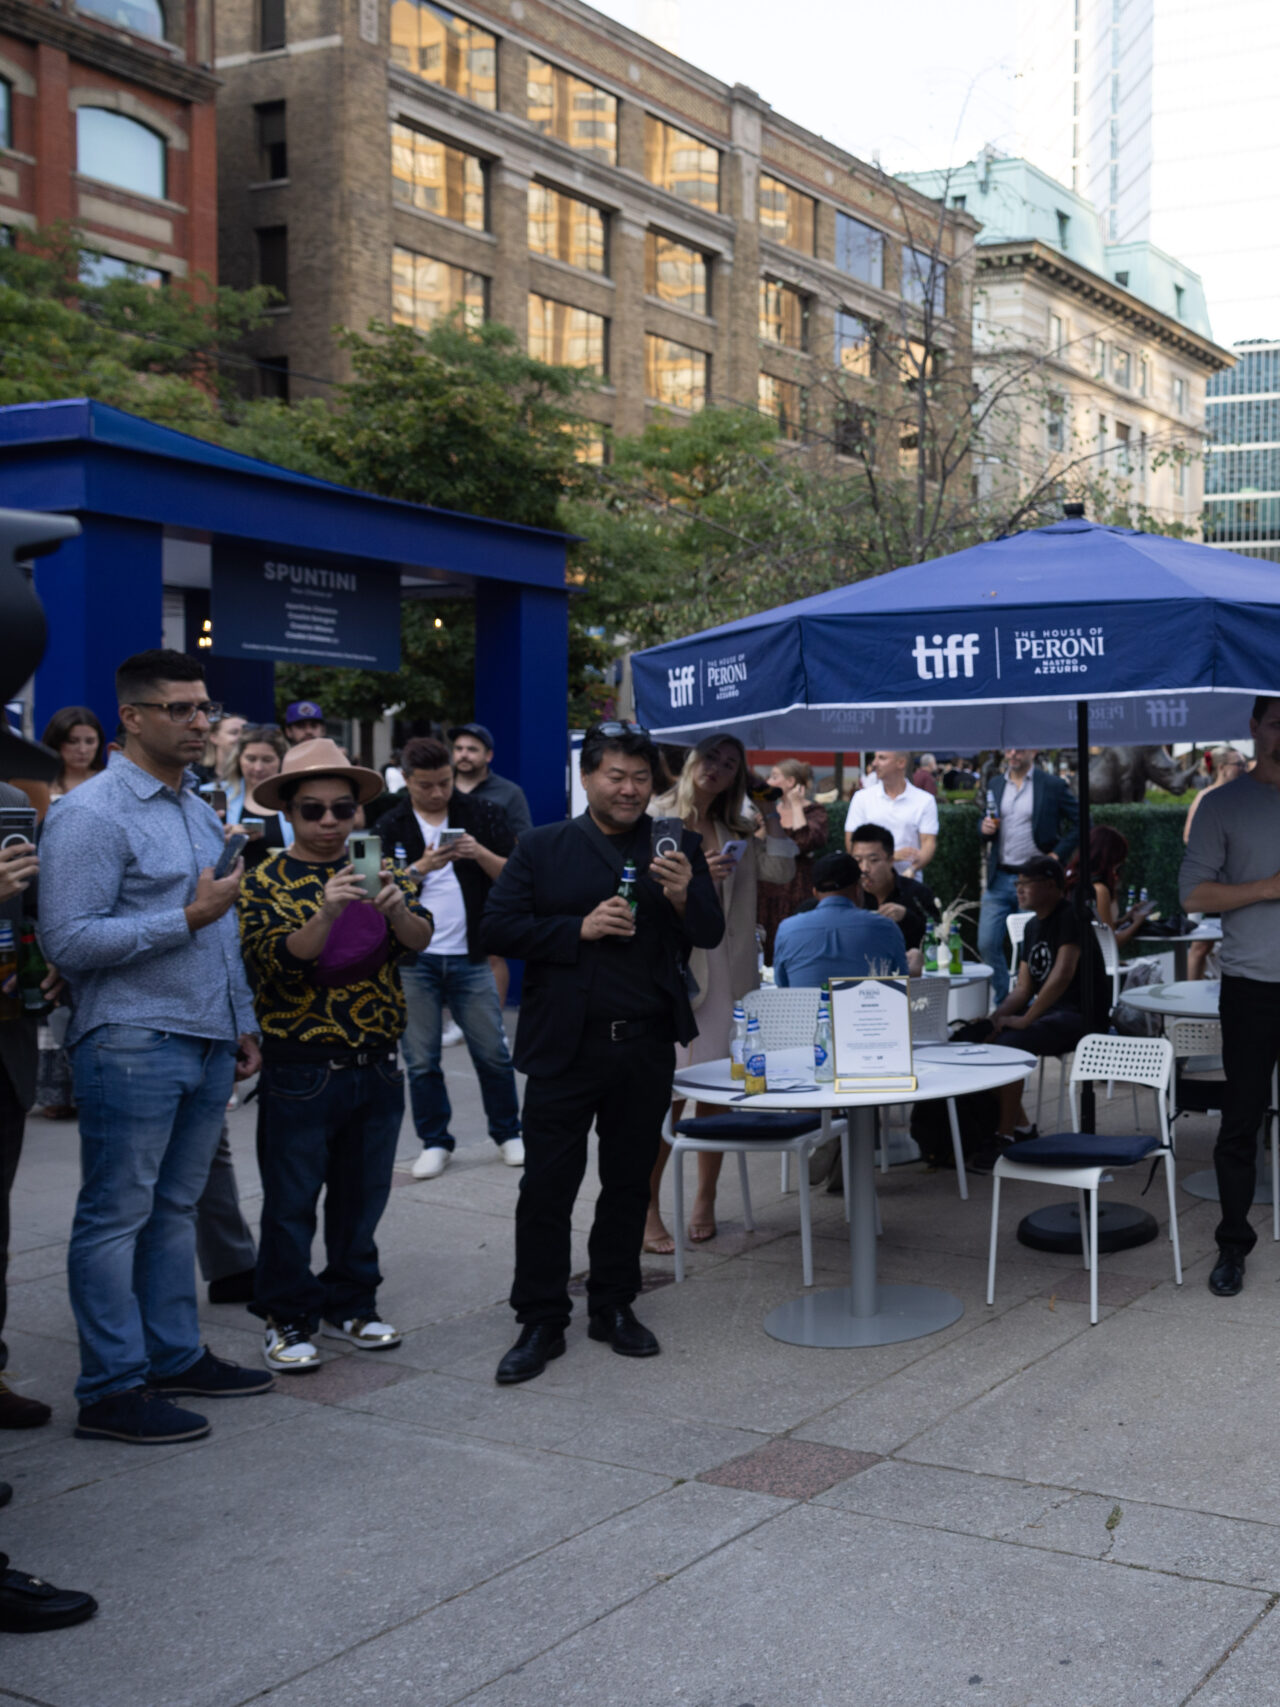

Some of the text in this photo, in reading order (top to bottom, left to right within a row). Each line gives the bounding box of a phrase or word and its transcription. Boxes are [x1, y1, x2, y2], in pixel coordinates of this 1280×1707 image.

[264, 561, 357, 592] SPUNTINI
[1014, 627, 1104, 639] THE HOUSE OF
[738, 653, 746, 661] OF
[912, 633, 980, 680] tiff
[1015, 636, 1105, 660] PERONI
[1034, 664, 1088, 675] AZZURRO
[1042, 658, 1078, 666] NASTRO
[668, 664, 695, 708] tiff
[707, 662, 747, 687] PERONI
